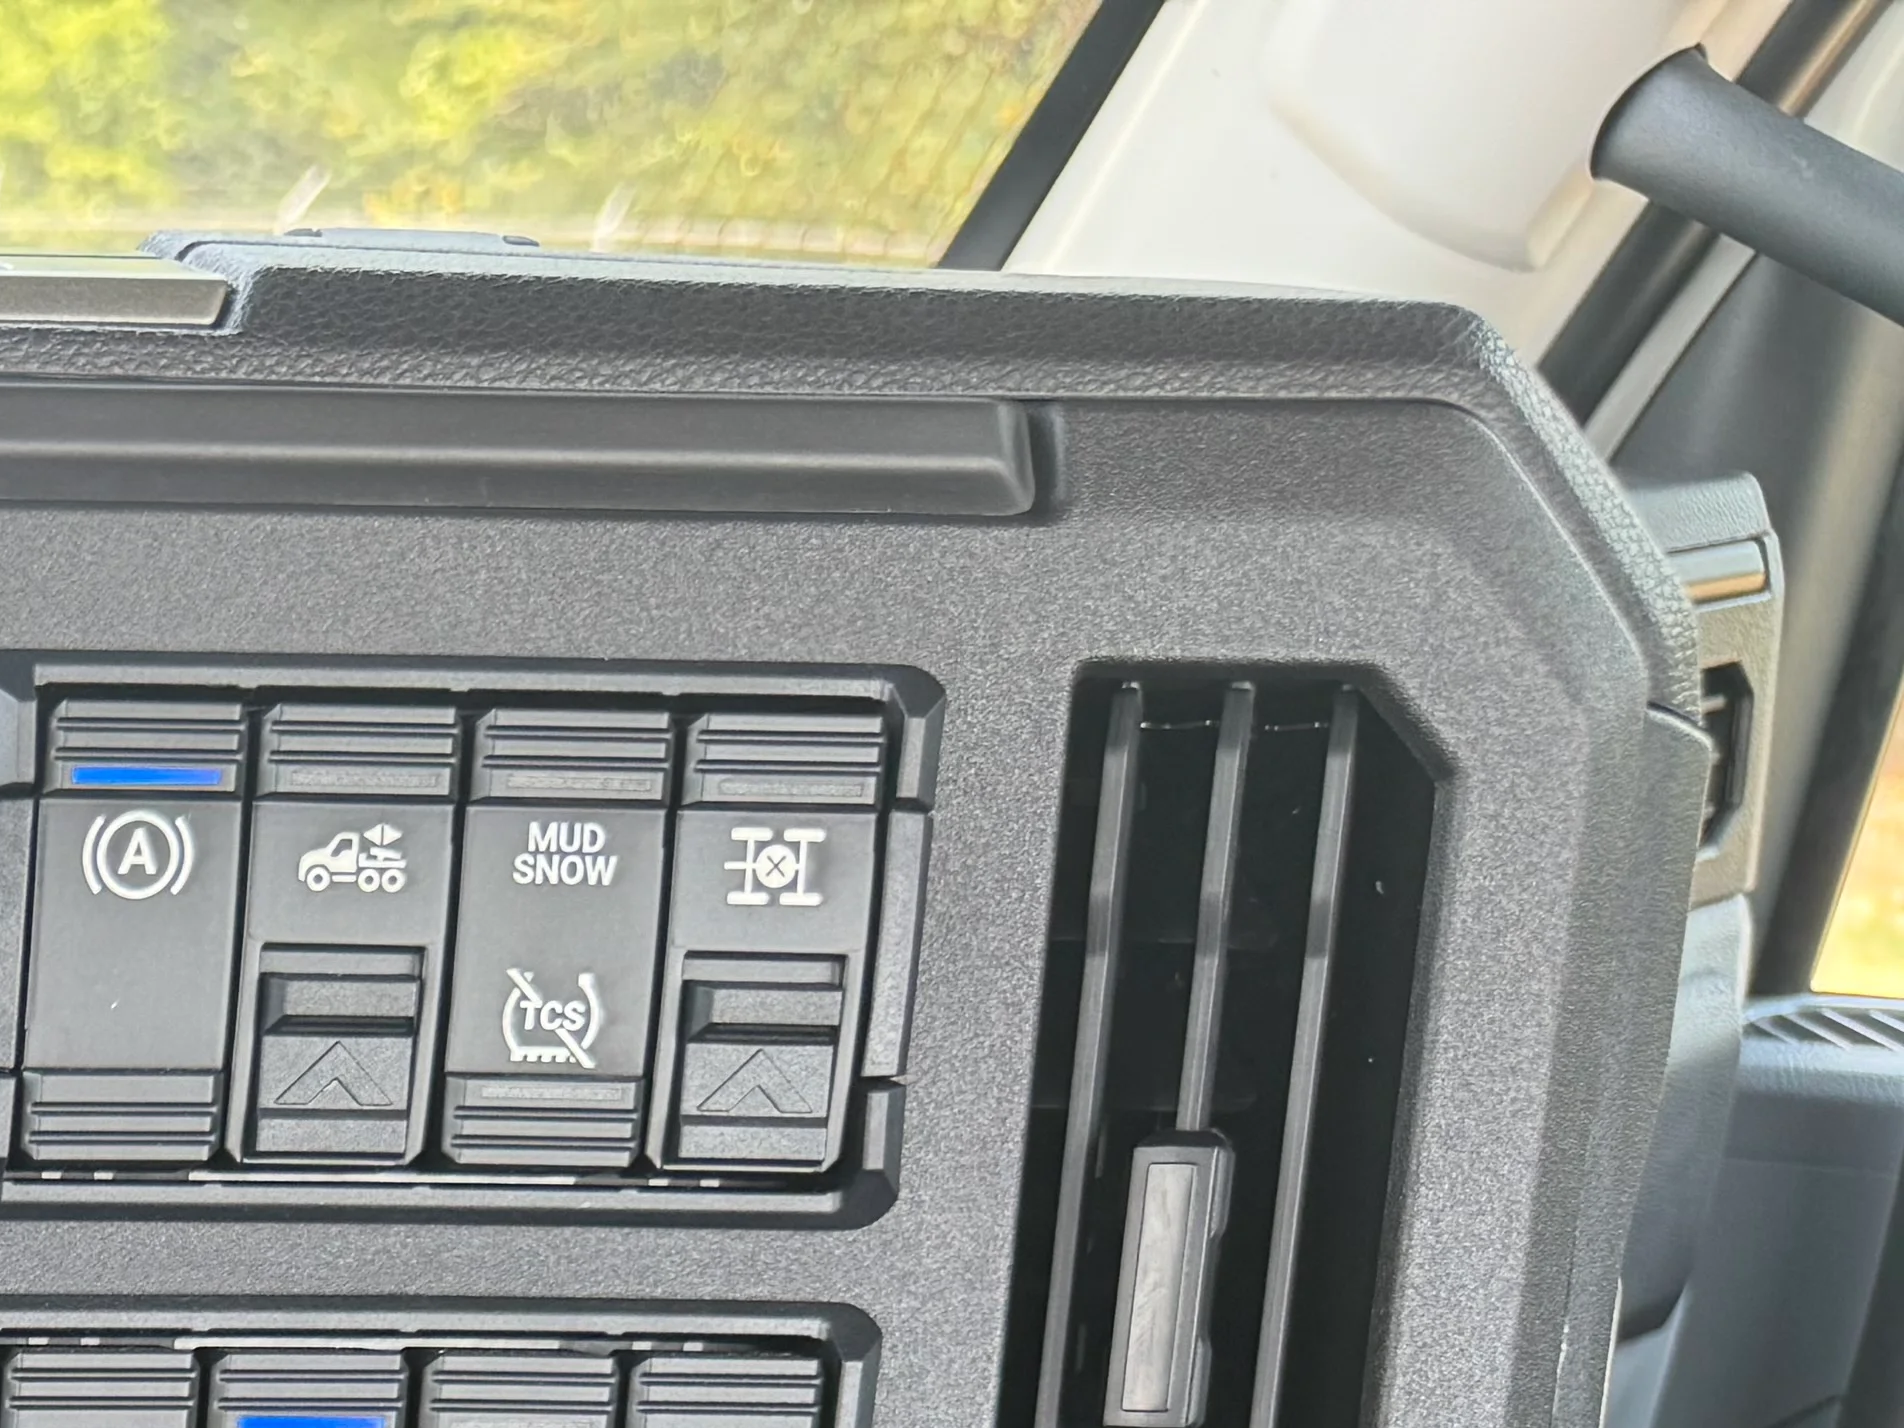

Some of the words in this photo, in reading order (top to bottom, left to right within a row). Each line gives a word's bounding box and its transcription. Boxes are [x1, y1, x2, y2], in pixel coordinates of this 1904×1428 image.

[117, 827, 158, 876] A
[527, 822, 605, 854] MUD
[512, 851, 619, 886] SNOW
[518, 999, 586, 1033] TCS
